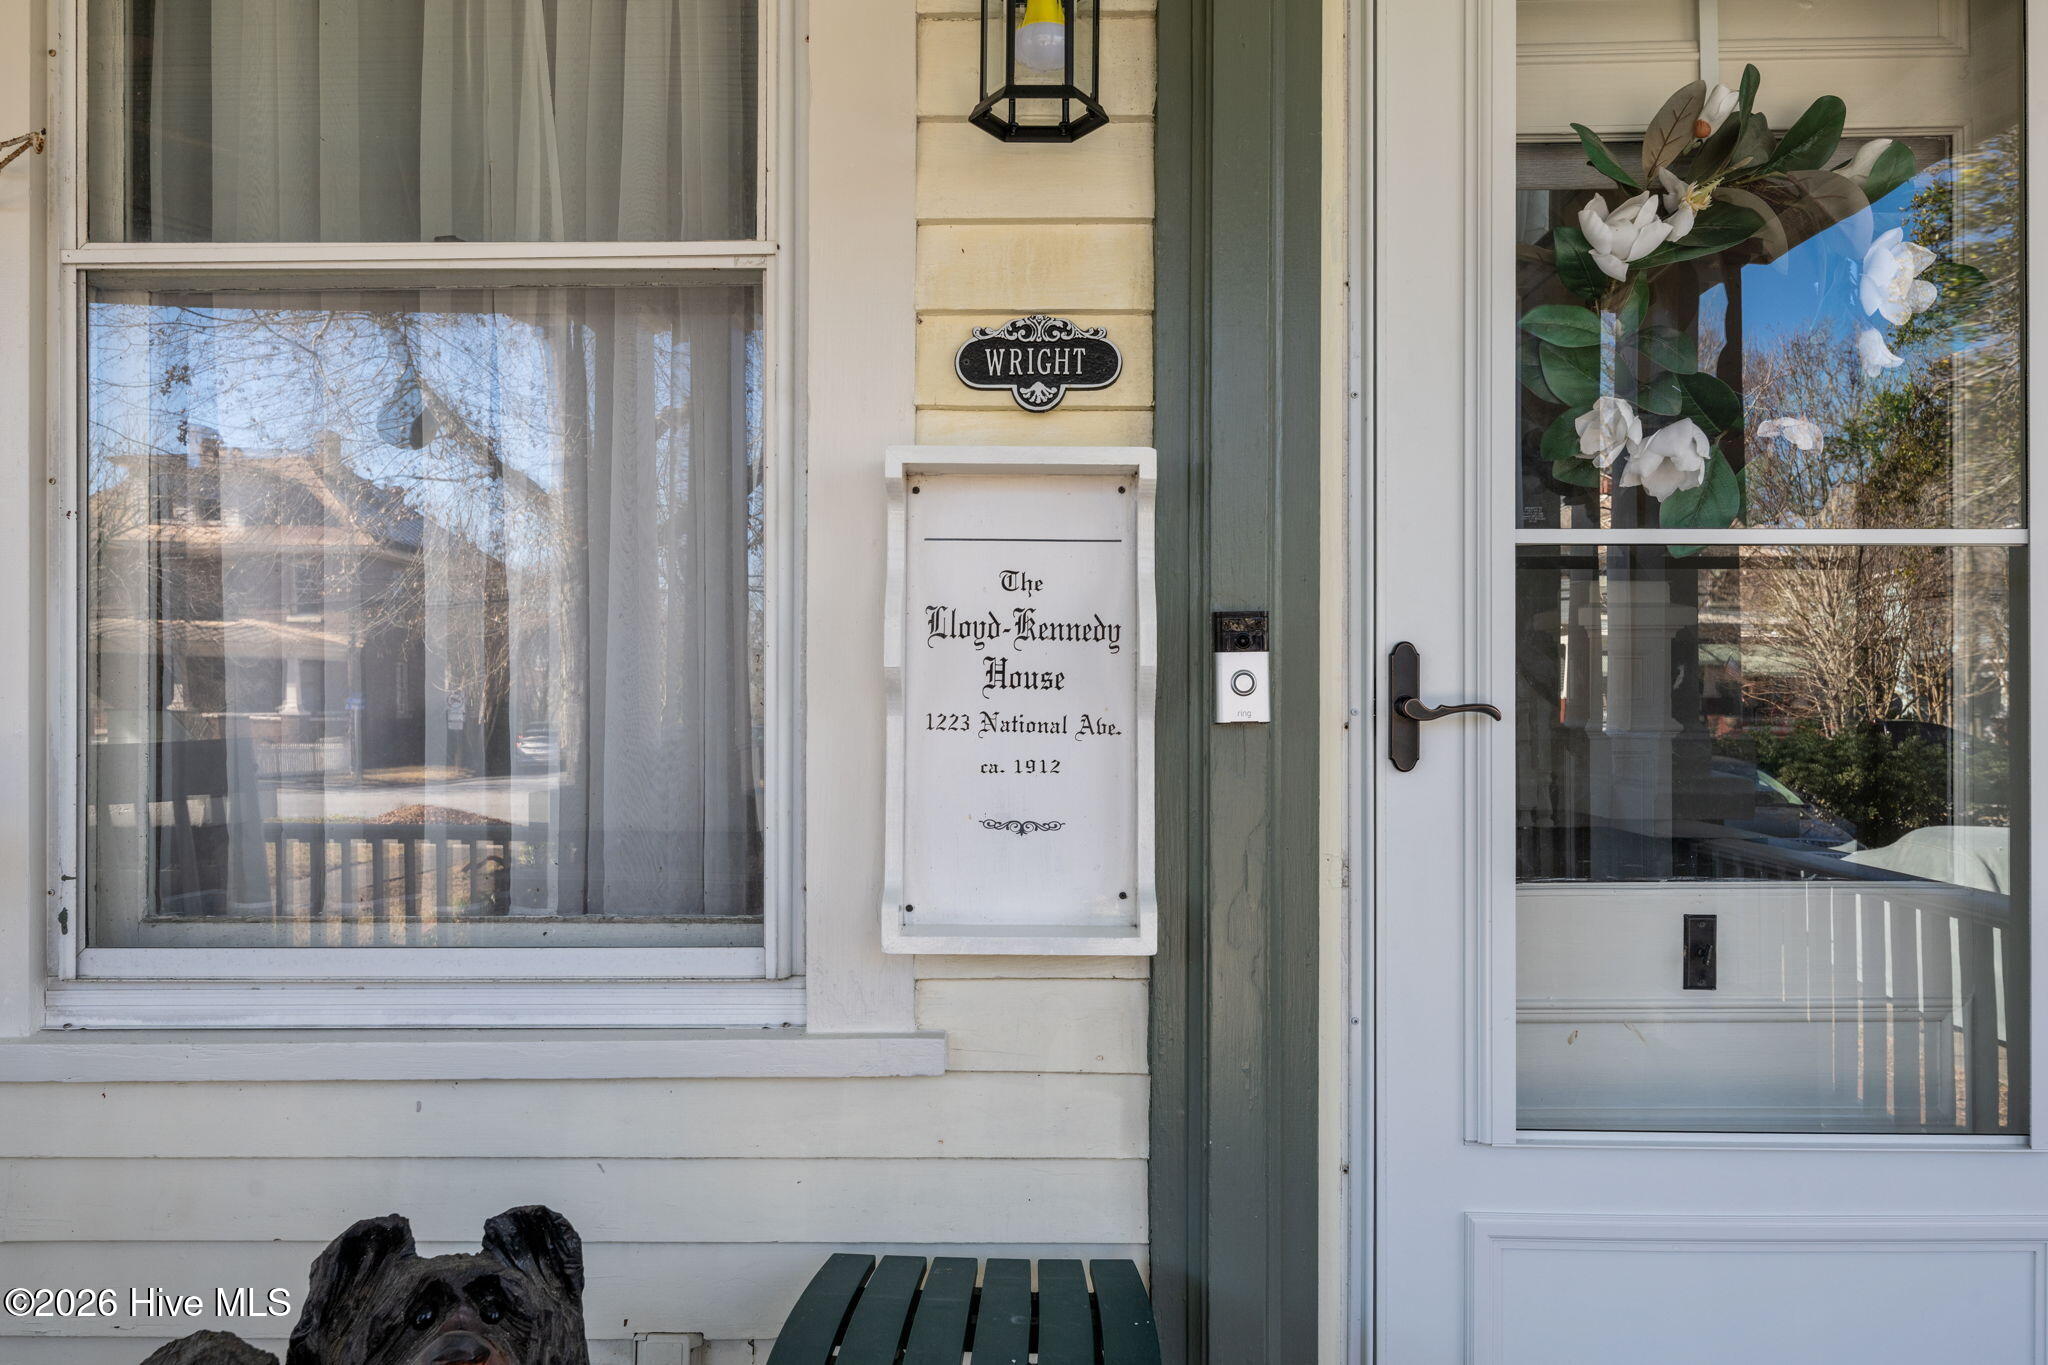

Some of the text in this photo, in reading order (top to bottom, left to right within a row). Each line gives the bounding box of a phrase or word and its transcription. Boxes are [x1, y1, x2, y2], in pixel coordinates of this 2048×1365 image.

[985, 347, 1086, 377] WRIGHT
[999, 569, 1044, 597] The
[925, 605, 1121, 654] Lloyd-Kennedy
[982, 656, 1065, 700] House
[926, 710, 1122, 742] 1223 National Ave.
[1237, 709, 1252, 719] ring
[980, 759, 1061, 774] ca. 1912
